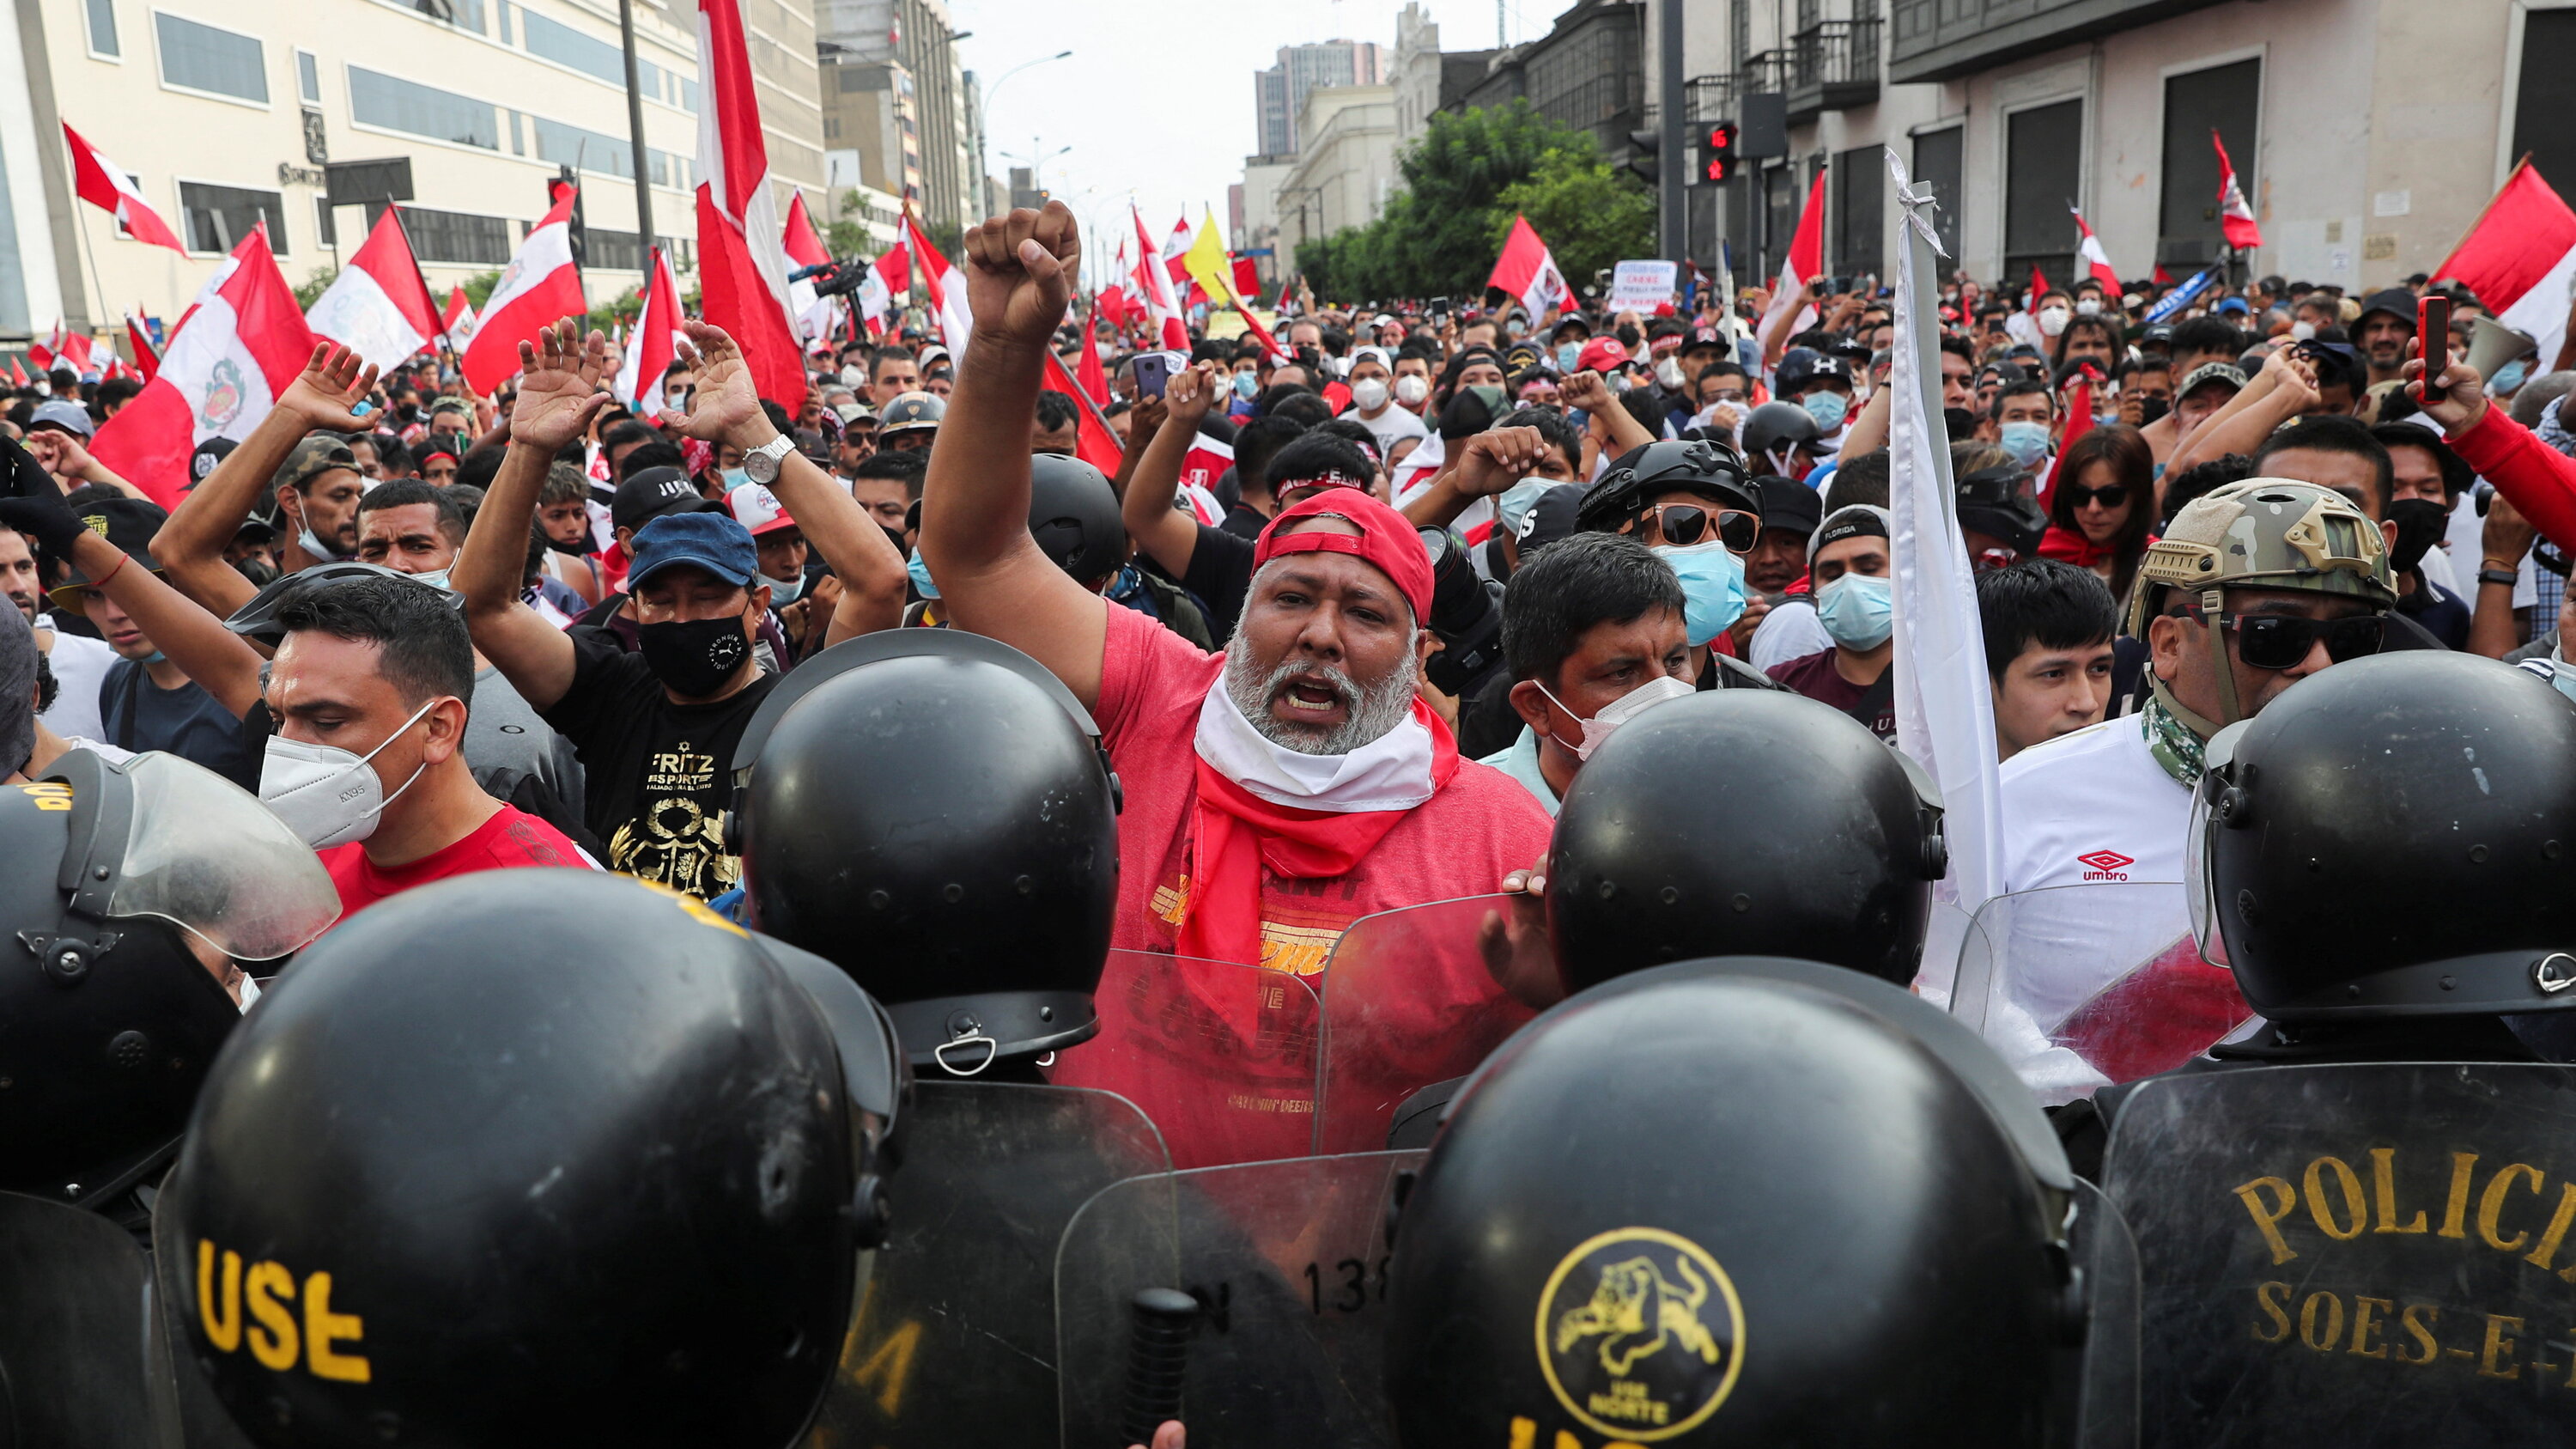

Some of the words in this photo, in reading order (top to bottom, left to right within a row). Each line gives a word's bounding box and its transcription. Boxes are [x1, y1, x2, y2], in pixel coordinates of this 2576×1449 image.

[1825, 525, 1856, 541] FLORIDA
[708, 634, 738, 657] STRONGER
[338, 785, 366, 803] KN95
[2083, 871, 2128, 881] umbro
[2233, 1148, 2576, 1284] POLICI
[197, 1238, 372, 1384] USE
[2251, 1281, 2576, 1389] SOES-E-
[1589, 1392, 1669, 1424] NORTE
